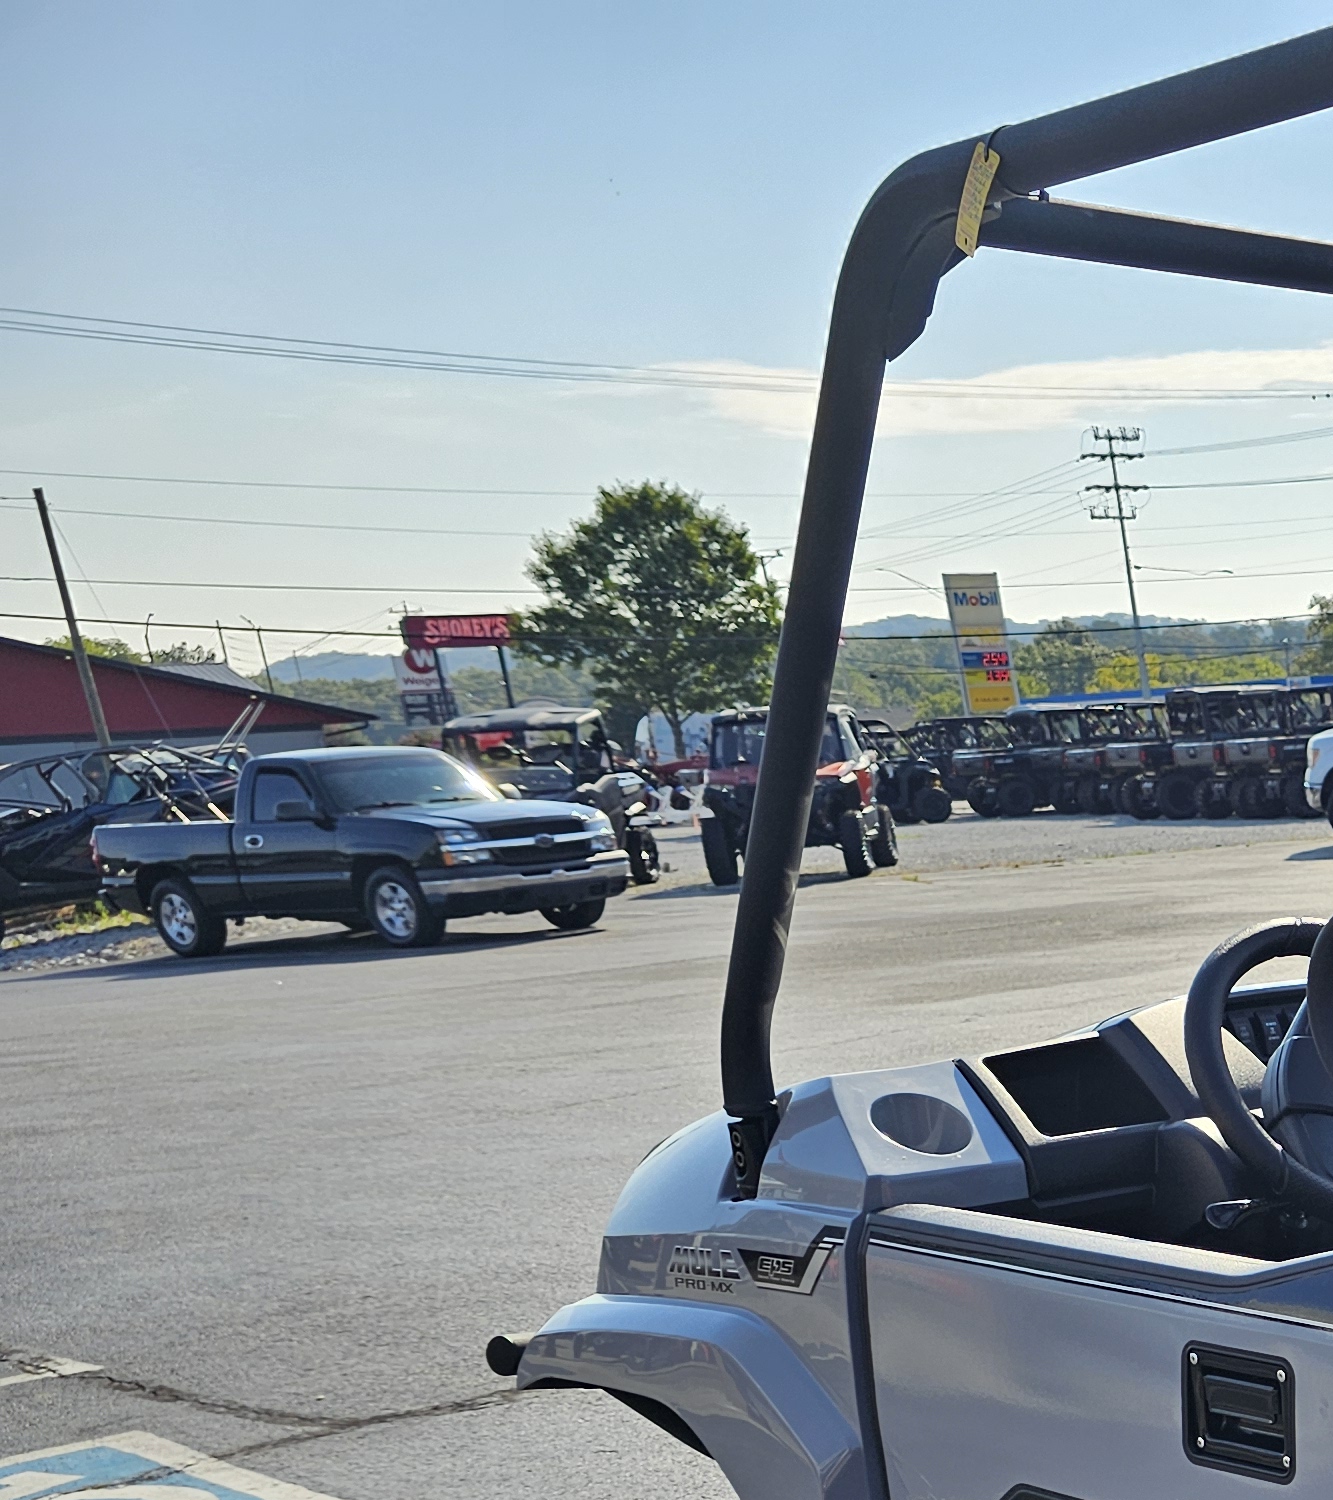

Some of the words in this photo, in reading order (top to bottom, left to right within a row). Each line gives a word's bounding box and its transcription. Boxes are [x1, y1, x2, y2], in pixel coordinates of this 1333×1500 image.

[953, 592, 998, 606] Mobil
[424, 618, 510, 644] SHONEY'S
[668, 1245, 743, 1281] MULE
[757, 1256, 794, 1276] EPS
[674, 1277, 734, 1294] PRO-MX
